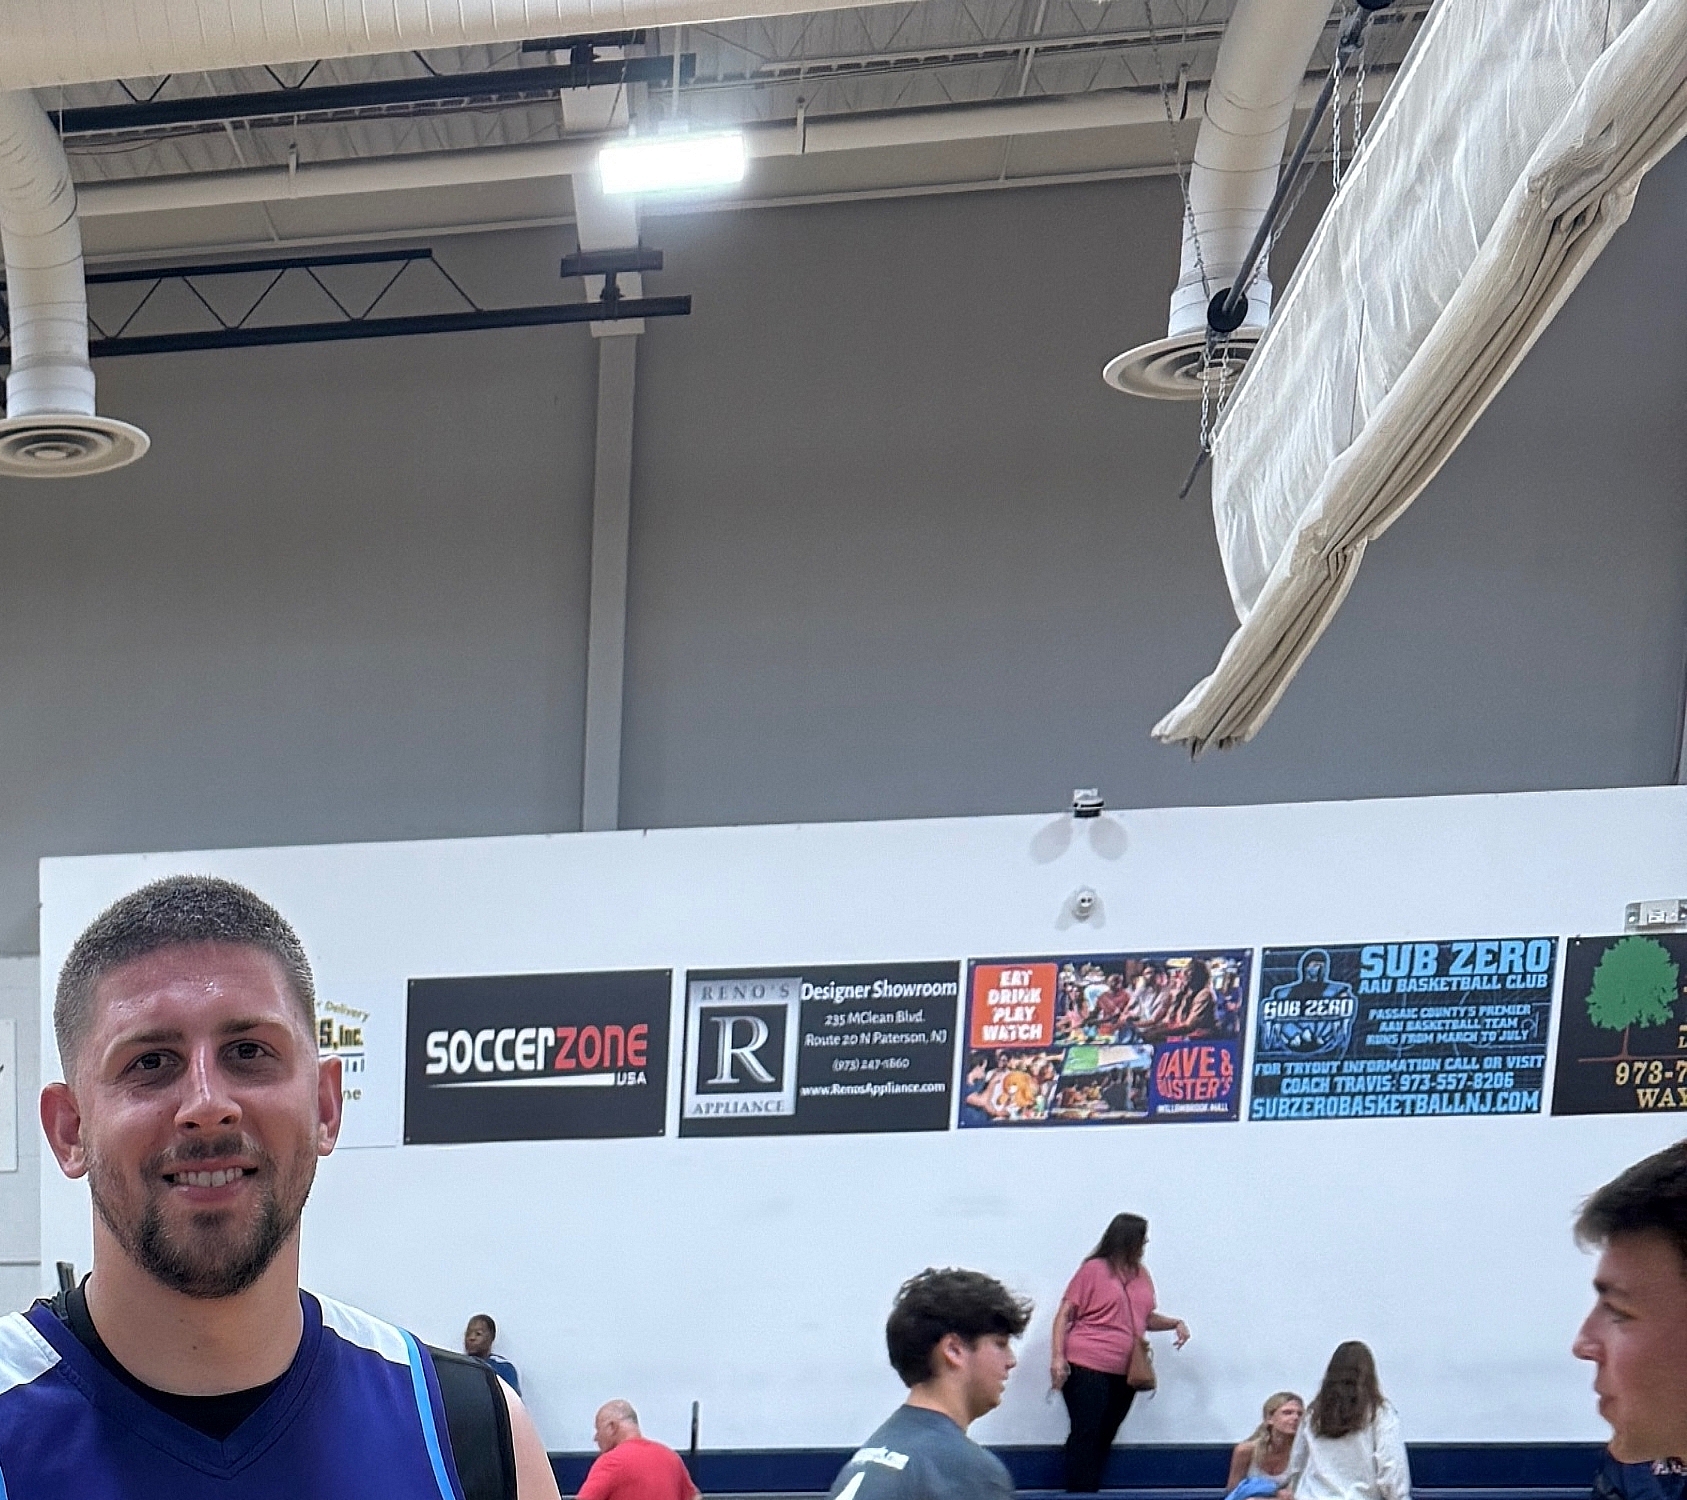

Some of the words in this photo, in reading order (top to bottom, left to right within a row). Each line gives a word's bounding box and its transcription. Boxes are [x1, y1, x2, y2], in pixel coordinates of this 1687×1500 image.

[1360, 943, 1438, 978] SUB
[1449, 939, 1551, 975] ZERO
[999, 969, 1033, 987] EAT
[1358, 978, 1392, 994] AAU
[1395, 976, 1501, 993] BASKETBALL
[1505, 973, 1548, 989] CLUB
[702, 984, 790, 1000] RENO'S
[801, 981, 872, 1004] Designer
[873, 978, 957, 999] Showroom
[987, 987, 1042, 1005] DRINK
[825, 1014, 846, 1027] 235
[895, 1009, 925, 1023] Blvd.
[993, 1006, 1035, 1023] PLAY
[1264, 1000, 1300, 1020] SUB
[1303, 999, 1353, 1018] ZERO
[1368, 1007, 1419, 1020] PASSAIC
[1420, 1005, 1476, 1018] COUNTY'S
[1478, 1004, 1531, 1017] PREMIER
[983, 1023, 1043, 1042] WATCH
[1379, 1021, 1404, 1032] AAU
[1405, 1019, 1481, 1031] BASKETBALL
[1485, 1017, 1518, 1029] TEAM
[804, 1033, 841, 1047] Route
[842, 1034, 858, 1045] 20
[859, 1032, 871, 1045] N
[872, 1031, 929, 1045] Paterson,
[930, 1029, 948, 1043] NJ
[1401, 1033, 1434, 1044] FROM
[1436, 1031, 1478, 1043] MARCH
[1480, 1030, 1496, 1042] TO
[1499, 1029, 1530, 1041] JULY
[706, 1015, 775, 1085] R
[1157, 1047, 1216, 1077] DAVE
[1254, 1063, 1281, 1076] FOR
[1283, 1061, 1340, 1075] TRYOUT
[1342, 1058, 1442, 1073] INFORMATION
[1444, 1057, 1479, 1070] CALL
[1483, 1056, 1503, 1069] OR
[1506, 1055, 1545, 1069] VISIT
[617, 1071, 647, 1086] USA
[1615, 1061, 1687, 1085] 973-7
[1281, 1076, 1328, 1094] COACH
[1334, 1074, 1398, 1092] TRAVIS:
[1400, 1072, 1514, 1090] 973-557-8206
[693, 1099, 785, 1115] APPLIANCE
[1252, 1091, 1540, 1118] SUBZEROBASKETBALLNJ.COM
